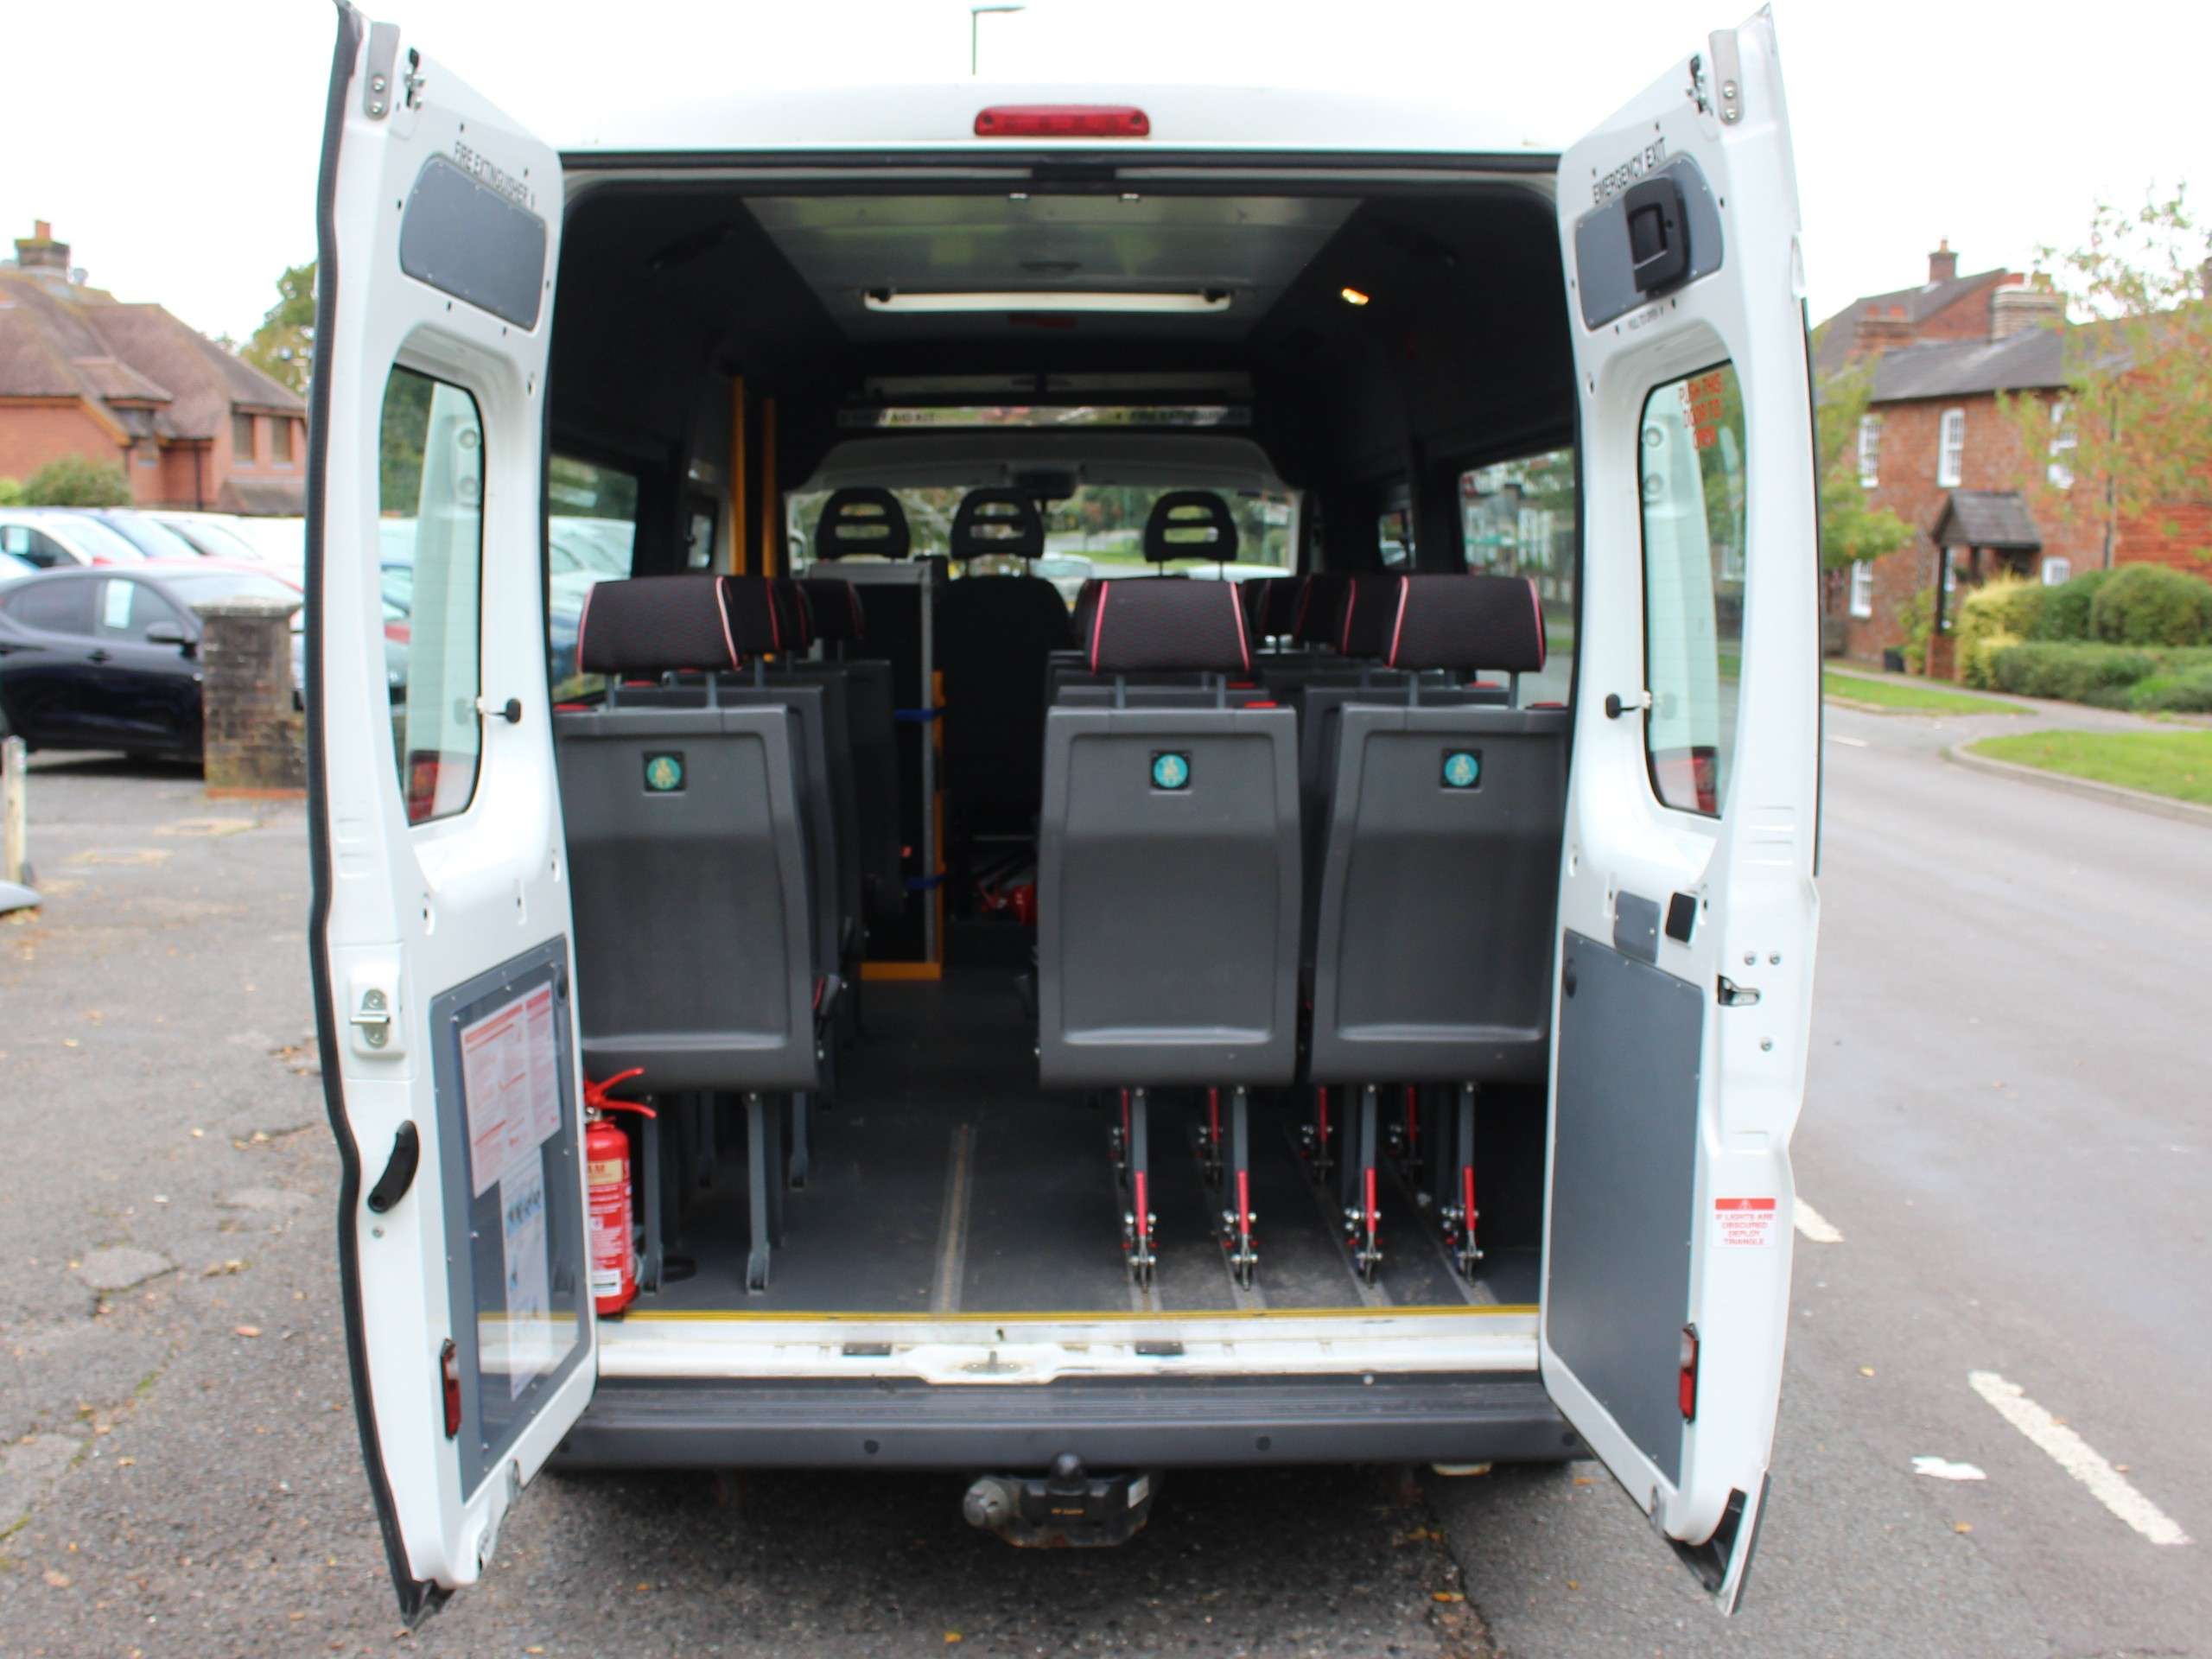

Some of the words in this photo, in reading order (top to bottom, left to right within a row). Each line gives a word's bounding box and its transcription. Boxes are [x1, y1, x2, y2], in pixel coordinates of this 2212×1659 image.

[454, 140, 473, 170] FIRE
[474, 153, 529, 207] EXTINGUISHER
[1592, 151, 1643, 204] EMERGENCY
[1645, 136, 1667, 168] EXIT
